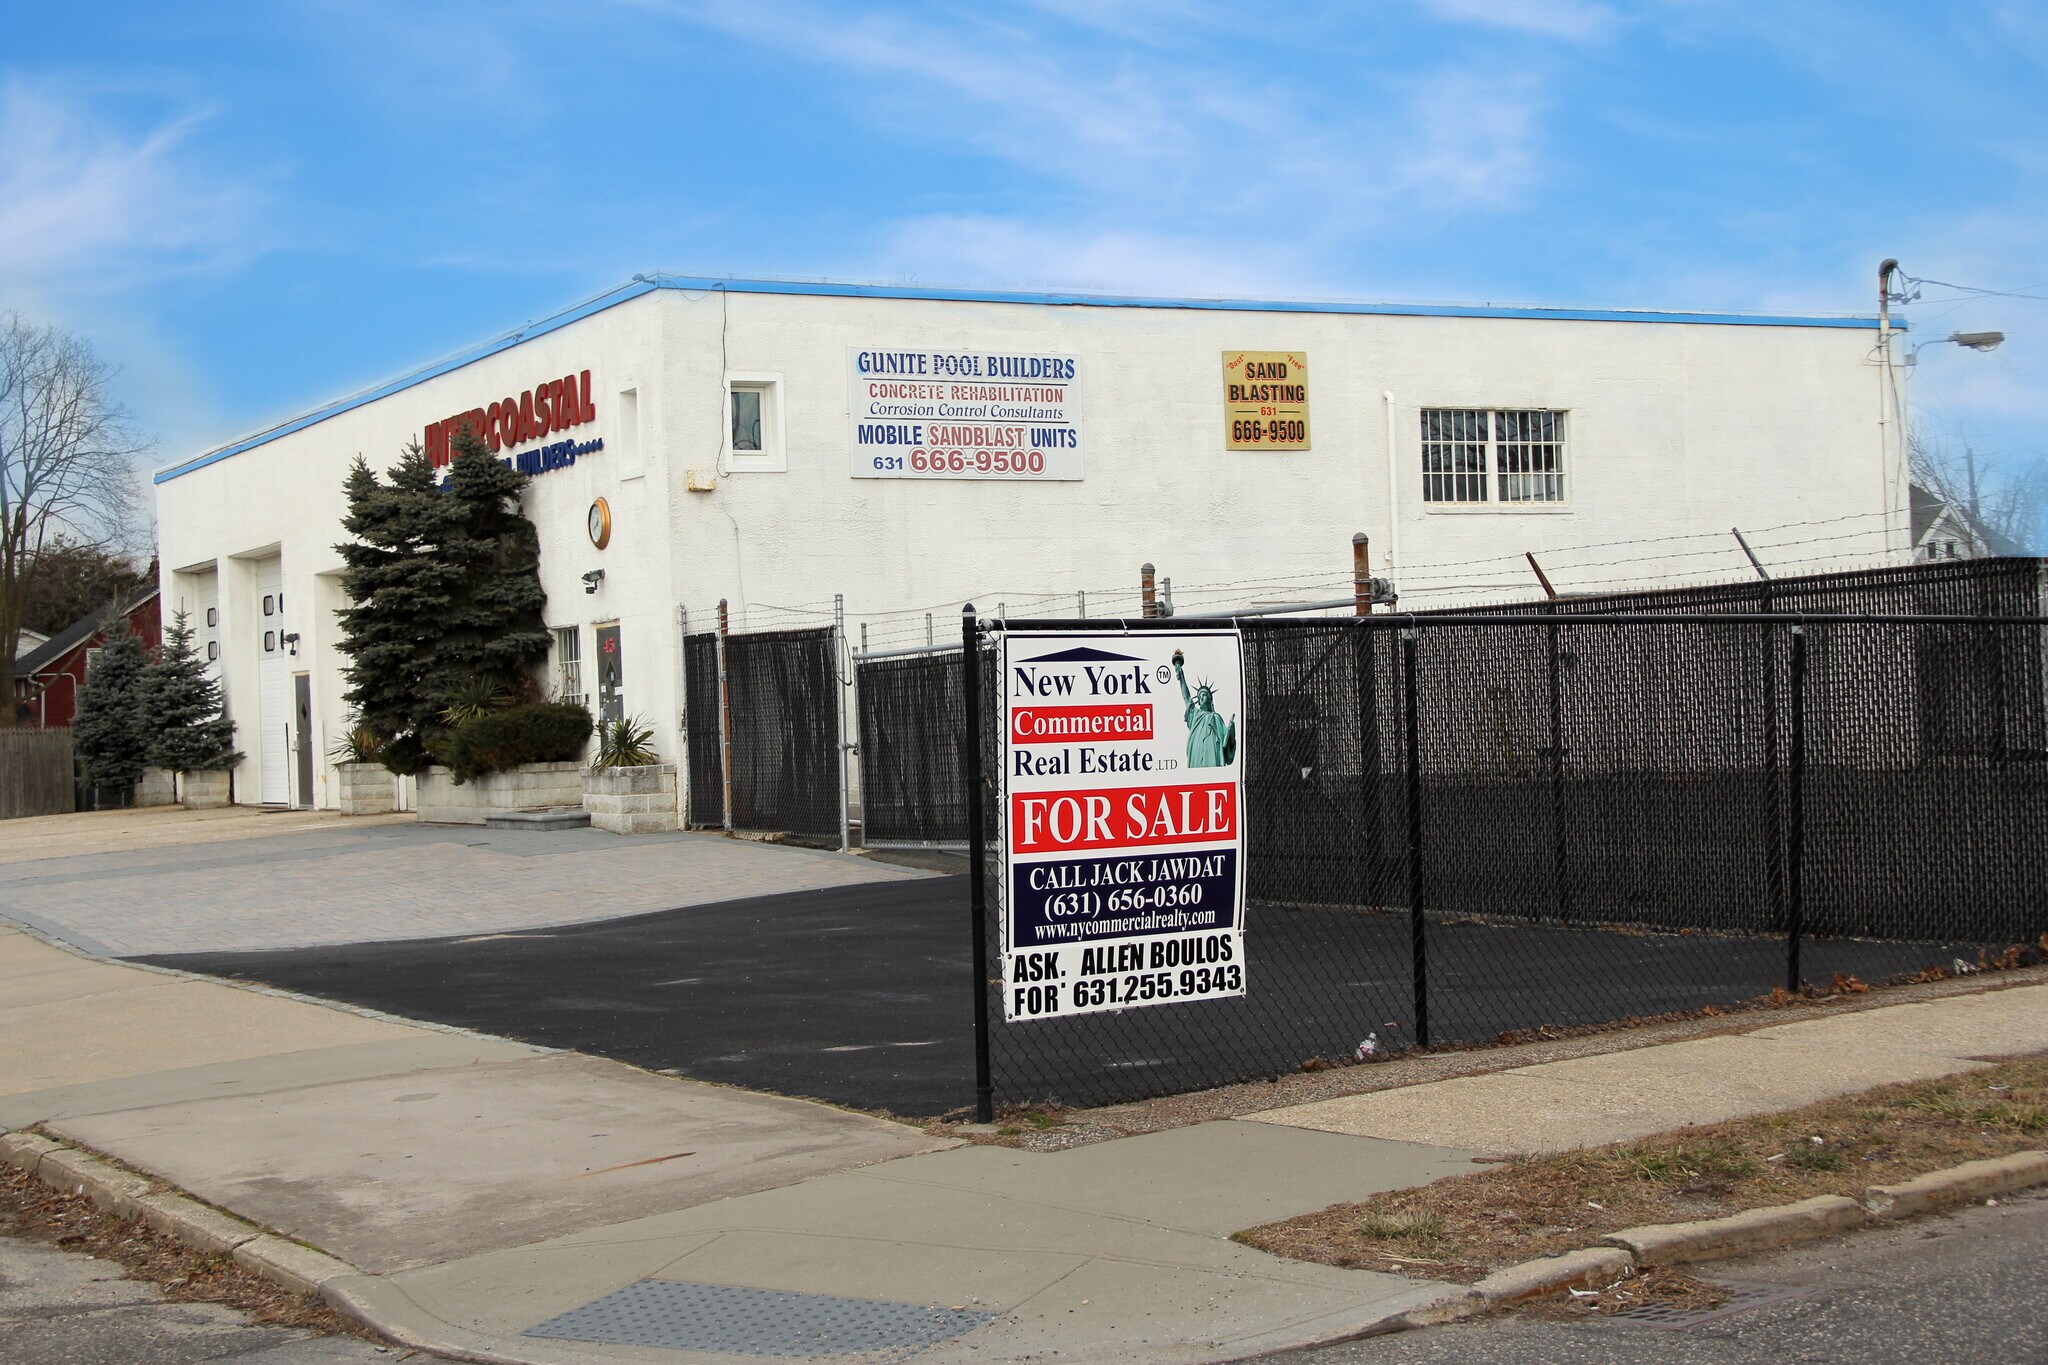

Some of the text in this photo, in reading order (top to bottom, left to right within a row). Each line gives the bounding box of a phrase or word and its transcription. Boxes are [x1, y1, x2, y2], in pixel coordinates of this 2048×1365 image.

[858, 352, 1075, 380] GUNITE POOL BUILDERS
[1245, 362, 1288, 381] SAND
[869, 383, 1064, 403] CONCRETE REHABILITATION
[1228, 384, 1305, 403] BLASTING
[869, 402, 1064, 419] Corrosion Control Consultants
[1260, 406, 1277, 416] 631
[858, 424, 1077, 448] MOBILE SANDBLAST UNITS
[1232, 420, 1305, 443] 666-9500
[873, 449, 1045, 473] 631 666-9500
[1013, 665, 1152, 697] New York
[1014, 707, 1152, 736] Commercial
[1013, 748, 1070, 776] Real
[1021, 789, 1230, 845] FOR SALE
[1029, 855, 1226, 890] CALL JACK JAWDAT
[1044, 883, 1203, 922] (631) 656-0360
[1034, 908, 1216, 940] www.nycommercialrealty.com
[1080, 943, 1145, 976] ALLEN
[1150, 934, 1233, 970] BOULOS
[1073, 964, 1242, 1008] 631.255.9343
